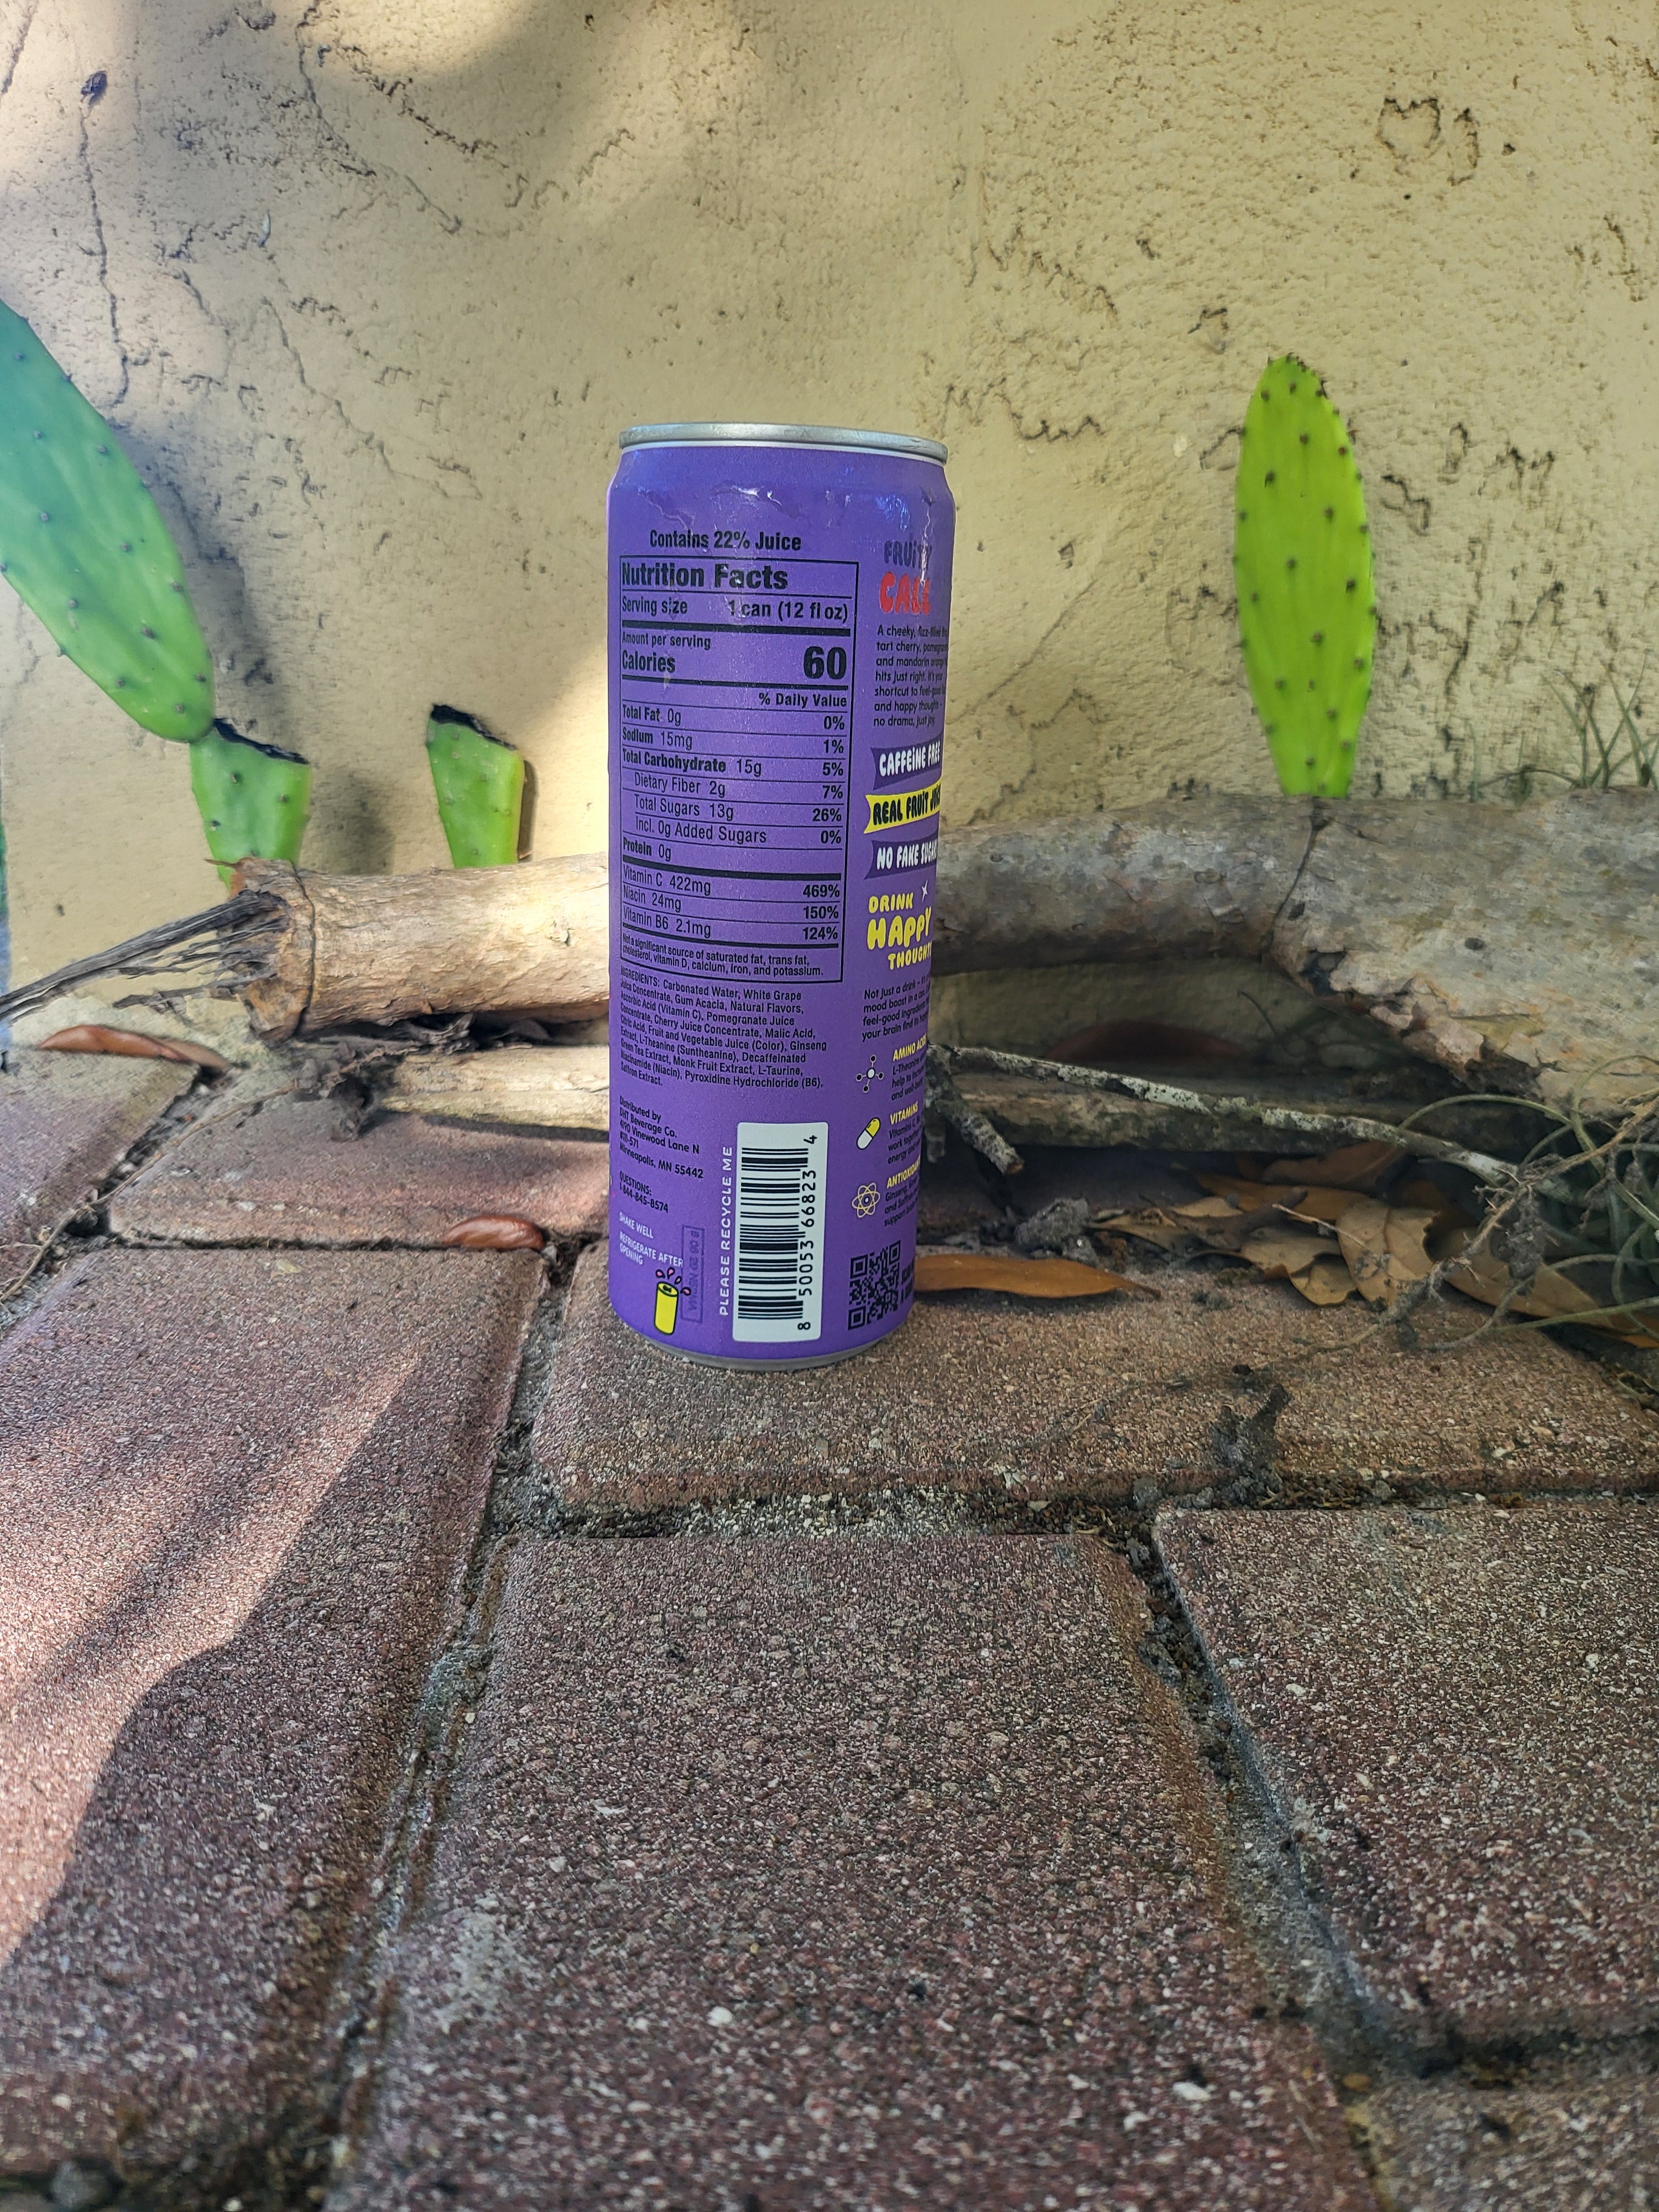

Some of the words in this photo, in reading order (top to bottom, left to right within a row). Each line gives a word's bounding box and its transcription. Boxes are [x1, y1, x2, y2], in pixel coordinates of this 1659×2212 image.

[650, 530, 709, 547] Contains
[714, 531, 750, 549] 22%
[755, 532, 801, 551] Juice
[623, 562, 704, 587] Nutrition
[714, 564, 788, 589] Facts
[879, 571, 931, 615] CALL
[623, 596, 657, 616] Serving
[662, 597, 687, 614] size
[729, 601, 734, 616] 1
[741, 603, 771, 617] can
[778, 602, 804, 622] (12
[810, 602, 820, 618] fl
[825, 603, 848, 623] oz)
[623, 632, 648, 644] Amount
[651, 635, 666, 647] per
[670, 635, 711, 650] serving
[878, 625, 883, 636] A
[877, 643, 893, 651] tart
[623, 650, 675, 672] Calories
[804, 646, 846, 679] 60
[877, 656, 893, 666] and
[896, 657, 929, 667] mandarin
[876, 671, 890, 681] hits
[893, 671, 907, 684] just
[759, 692, 770, 705] %
[776, 693, 807, 708] Daily
[813, 694, 847, 707] Value
[875, 686, 909, 696] shortcut
[912, 687, 917, 696] to
[623, 705, 640, 719] Total
[645, 708, 660, 721] Fat
[668, 708, 681, 726] 0g
[824, 716, 844, 730] 0%
[874, 701, 891, 711] and
[895, 701, 917, 714] happy
[874, 718, 885, 726] no
[623, 727, 653, 743] Sodium
[661, 731, 692, 750] 15mg
[824, 739, 844, 754] 1%
[623, 748, 640, 764] Total
[644, 752, 726, 772] Carbohydrate
[737, 760, 761, 776] 15g
[823, 762, 843, 776] 5%
[928, 740, 940, 767] FREE
[635, 772, 667, 792] Dietary
[672, 777, 700, 793] Fiber
[710, 781, 726, 797] 2g
[822, 785, 843, 799] 7%
[635, 794, 656, 811] Total
[660, 799, 700, 816] Sugars
[710, 804, 733, 821] 13g
[812, 808, 842, 822] 26%
[873, 799, 902, 825] REAL
[637, 816, 654, 833] Incl.
[658, 820, 670, 837] 0g
[675, 823, 713, 839] Added
[719, 826, 766, 844] Sugars
[821, 830, 841, 844] 0%
[623, 836, 651, 856] Protein
[659, 844, 671, 861] 0g
[877, 846, 893, 870] NO
[896, 844, 919, 868] FAKE
[624, 867, 652, 885] Vitamin
[656, 873, 662, 886] C
[670, 875, 711, 896] 422mg
[803, 884, 839, 898] 469%
[624, 885, 645, 904] Niacin
[652, 893, 681, 912] 24mg
[804, 905, 839, 919] 150%
[869, 892, 913, 913] DRINK
[624, 906, 651, 926] Vitamin
[656, 915, 668, 930] B6
[676, 919, 711, 938] 2.1mg
[803, 926, 838, 940] 124%
[867, 906, 931, 950] HAPPY
[654, 954, 680, 967] vitamin
[692, 961, 728, 974] calcium,
[754, 966, 770, 975] and
[774, 967, 823, 977] potassium.
[668, 946, 693, 958] source
[696, 949, 704, 959] of
[706, 950, 748, 963] saturated
[751, 955, 766, 966] fat,
[769, 955, 792, 965] trans
[795, 955, 809, 967] fat,
[664, 980, 708, 995] Carbonated
[743, 989, 770, 1000] White
[774, 990, 801, 1002] Grape
[864, 989, 879, 999] Not
[880, 987, 894, 1000] just
[675, 994, 693, 1006] Gum
[731, 1001, 764, 1013] Natural
[768, 1003, 804, 1014] Flavors,
[864, 1000, 886, 1013] mood
[889, 997, 906, 1008] boost
[655, 1015, 678, 1029] Cherry
[680, 1020, 701, 1032] Juice
[765, 1029, 790, 1037] Malic
[707, 1012, 767, 1025] Pomegranate
[770, 1016, 794, 1025] Juice
[863, 1011, 900, 1026] feel-good
[648, 1025, 663, 1037] Fruit
[666, 1031, 679, 1041] and
[681, 1033, 722, 1047] Vegetable
[725, 1039, 749, 1048] Juice
[790, 1041, 827, 1051] Ginseng
[862, 1029, 880, 1042] your
[883, 1024, 901, 1036] brain
[674, 1055, 695, 1068] Monk
[698, 1060, 717, 1071] Fruit
[743, 1052, 806, 1062] Decaffeinated
[893, 1042, 915, 1061] AMINO
[733, 1076, 799, 1087] Hydrochloride
[892, 1077, 905, 1088] help
[620, 1095, 649, 1118] Distributed
[652, 1110, 661, 1124] by
[890, 1101, 918, 1125] VITAMINS
[620, 1107, 629, 1119] DHT
[631, 1115, 661, 1134] Beverage
[665, 1126, 677, 1138] Co.
[633, 1126, 665, 1147] Vinewood
[669, 1139, 689, 1152] Lane
[693, 1144, 699, 1154] N
[804, 1135, 817, 1144] 4
[659, 1159, 671, 1172] MN
[675, 1164, 703, 1178] 55442
[723, 1146, 732, 1171] ME
[620, 1171, 651, 1196] QUESTIONS:
[620, 1183, 668, 1213] 1-844-845-8574
[801, 1171, 816, 1227] 66823
[620, 1212, 634, 1230] SHAKE
[637, 1222, 654, 1239] WELL
[721, 1176, 732, 1250] RECYCLE
[620, 1231, 656, 1259] REFRIGERATE
[658, 1252, 683, 1267] AFTER
[799, 1240, 814, 1296] 50053
[720, 1256, 730, 1316] PLEASE
